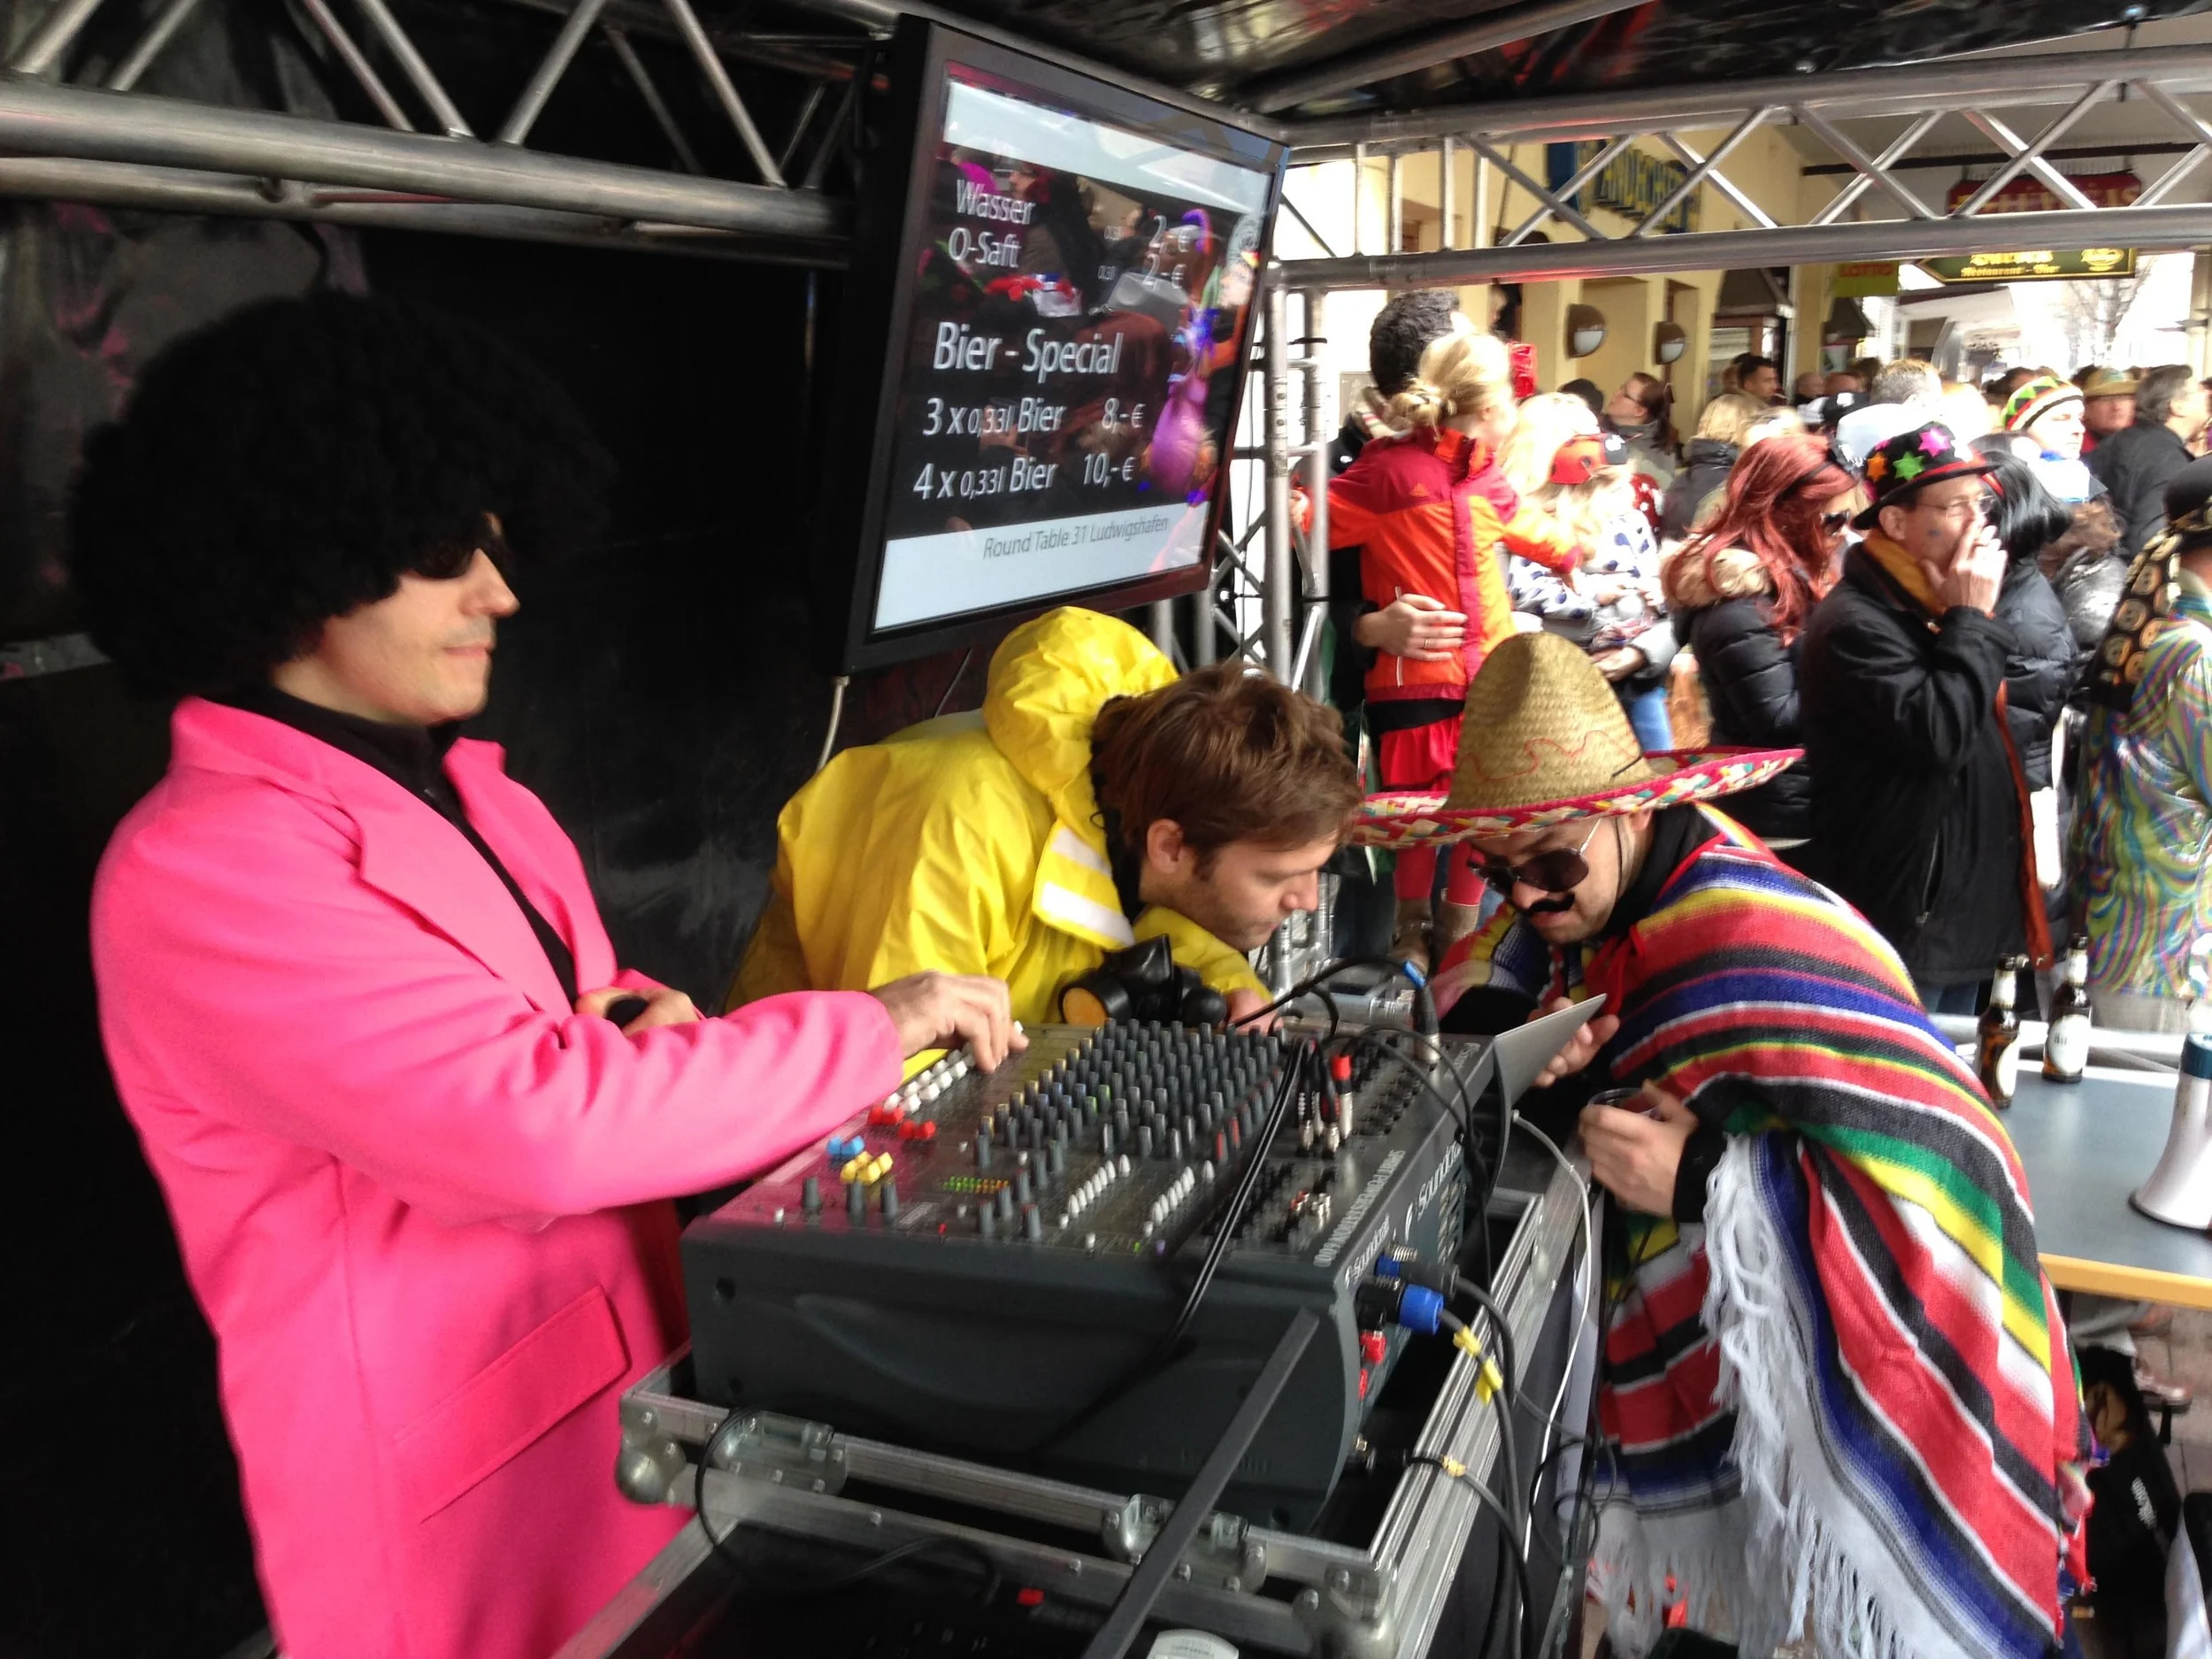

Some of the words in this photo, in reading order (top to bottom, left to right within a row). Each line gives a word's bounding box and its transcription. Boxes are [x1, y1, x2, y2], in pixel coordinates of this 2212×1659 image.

[956, 179, 1035, 225] Wasser
[949, 227, 1021, 267] O-Saft
[933, 321, 1002, 370] Bier
[1022, 328, 1124, 383] Special
[922, 397, 944, 436] 3
[946, 406, 966, 434] x
[1017, 397, 1066, 433] Bier
[912, 463, 934, 500] 4
[936, 471, 957, 499] x
[1008, 457, 1059, 492] Bier
[983, 531, 1031, 559] Round
[1033, 528, 1068, 551] Table
[1070, 525, 1087, 546] 31
[1089, 513, 1170, 542] Ludwigshafen
